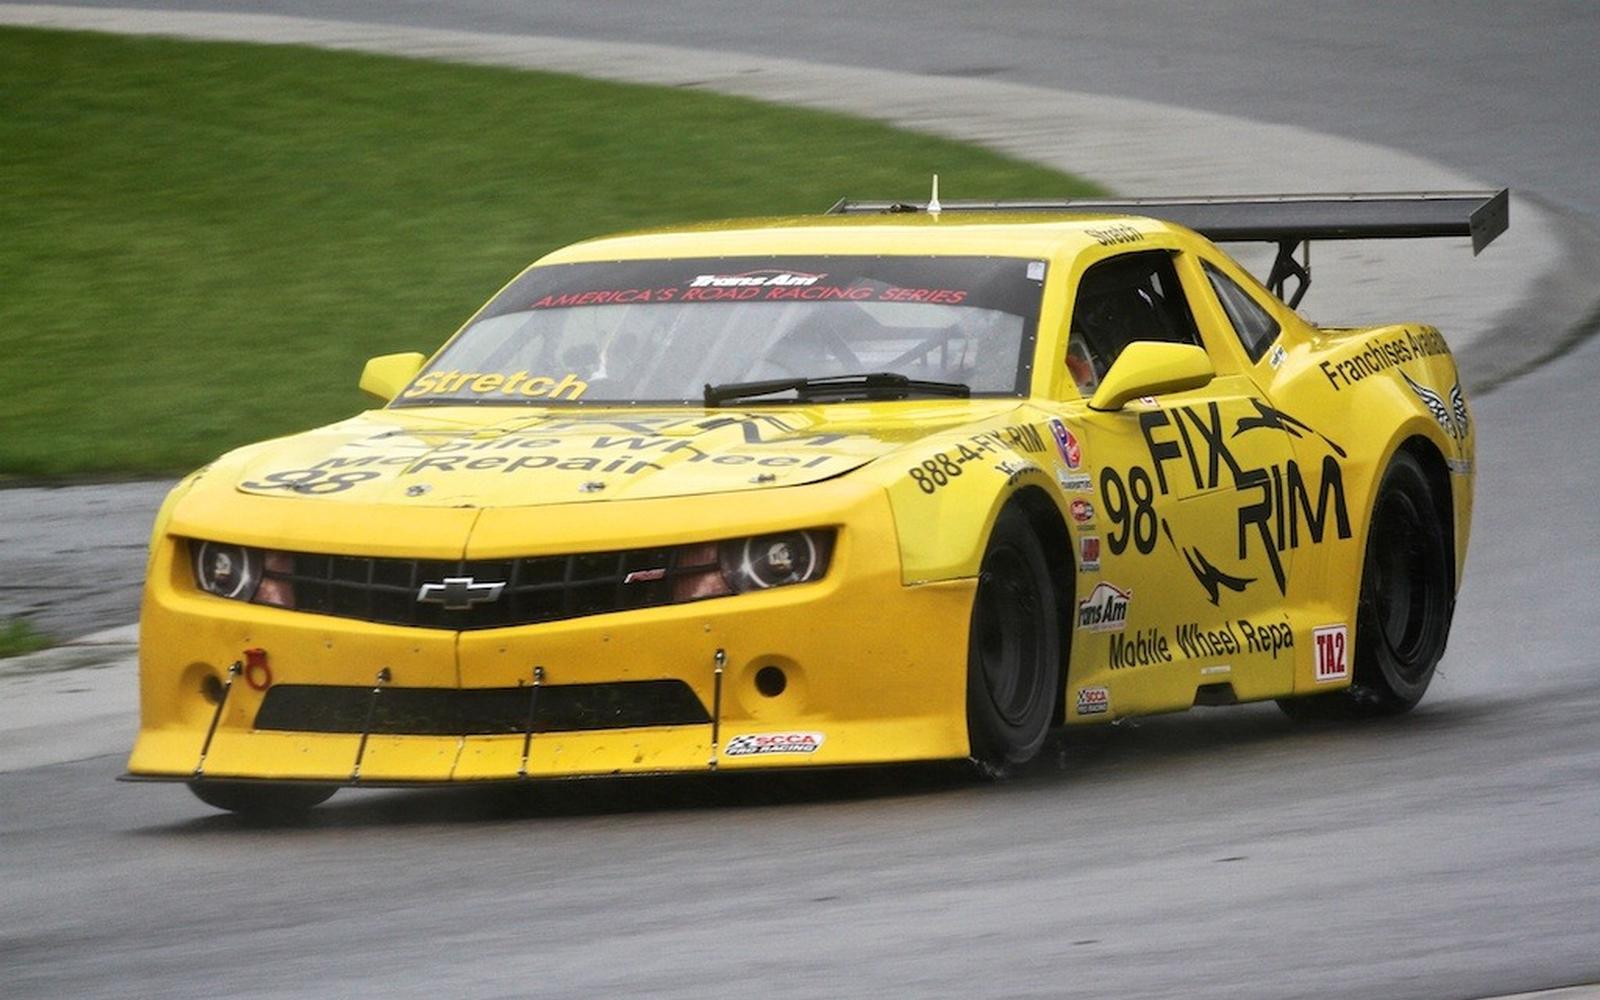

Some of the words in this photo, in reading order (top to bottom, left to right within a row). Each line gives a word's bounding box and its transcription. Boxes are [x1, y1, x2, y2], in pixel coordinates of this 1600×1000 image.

[1084, 224, 1145, 246] Stretch
[689, 275, 765, 287] Trans
[763, 274, 818, 286] Am
[531, 288, 678, 308] AMERICA'S
[681, 287, 761, 300] ROAD
[765, 287, 875, 300] RACING
[879, 287, 967, 303] SERIES
[1319, 338, 1413, 391] Franchises
[403, 369, 588, 400] Stretch
[1139, 400, 1246, 495] FIX
[240, 468, 381, 495] 98
[406, 454, 665, 481] Repair
[1100, 465, 1158, 556] 98
[1237, 454, 1352, 597] RIM
[1101, 595, 1127, 624] Am
[1108, 629, 1173, 670] Mobile
[1176, 621, 1241, 659] Wheel
[1316, 632, 1346, 675] TA2
[756, 735, 816, 745] SCCA
[757, 744, 817, 754] RACING
